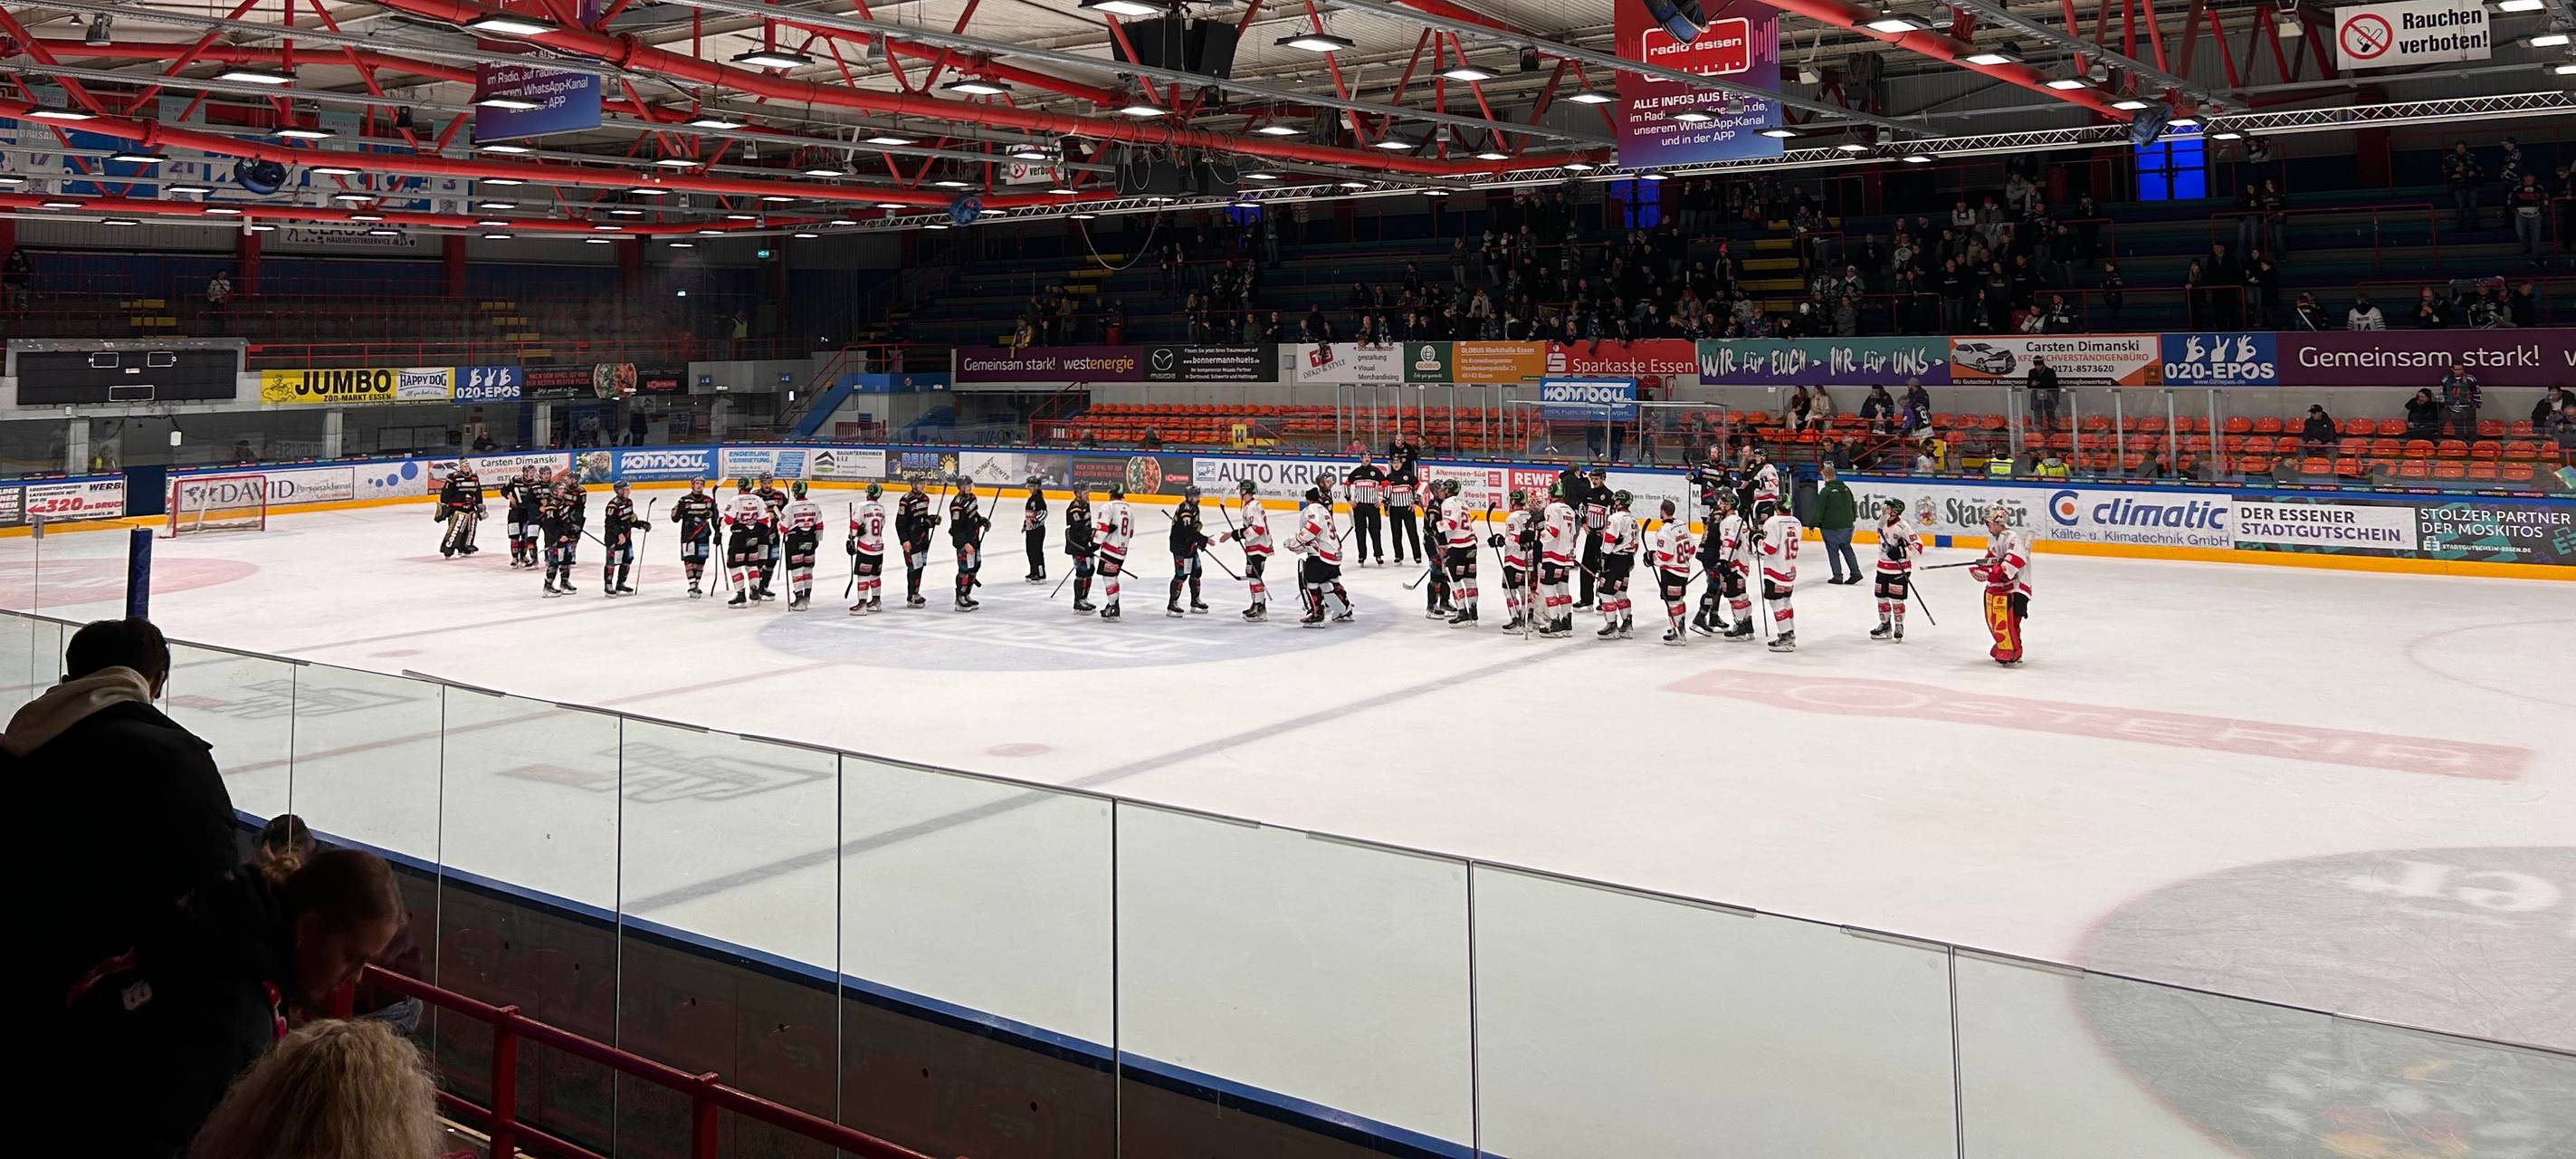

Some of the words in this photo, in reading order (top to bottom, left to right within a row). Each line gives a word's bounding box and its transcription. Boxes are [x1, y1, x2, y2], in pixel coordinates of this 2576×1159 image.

[2402, 8, 2482, 30] Rauchen
[1650, 43, 1690, 56] radio
[1694, 38, 1741, 51] essen
[2399, 31, 2488, 54] verboten!
[498, 72, 520, 85] Radio,
[523, 77, 588, 96] WhatsApp-Kanal
[548, 95, 567, 109] APP
[1633, 99, 1659, 110] ALLE
[1662, 95, 1694, 107] INFOS
[1697, 92, 1720, 103] AUS
[1630, 114, 1642, 123] im
[1634, 123, 1676, 136] unserem
[1679, 115, 1765, 131] WhatsApp-Kanal
[1662, 136, 1681, 147] und
[1682, 135, 1692, 144] in
[1693, 132, 1710, 143] der
[1713, 130, 1736, 142] APP
[326, 235, 391, 245] HAUSMEISTERSERVICE
[2026, 341, 2074, 354] Carsten
[2077, 340, 2140, 353] Dimanski
[964, 357, 1023, 372] Gemeinsam
[1026, 357, 1056, 370] stark!
[1064, 356, 1134, 373] westenergie
[1702, 347, 1736, 377] WIR
[1771, 346, 1807, 375] EUCH
[1829, 346, 1853, 374] IHR
[1894, 346, 1928, 375] UNS
[2299, 346, 2452, 368] Gemeinsam
[2462, 345, 2540, 368] stark!
[1303, 368, 1321, 378] DEKO
[1573, 357, 1646, 377] Sparkasse
[1650, 358, 1694, 374] Essen
[2051, 363, 2114, 374] 0171-8573620
[2164, 362, 2275, 379] 020-EPOS
[294, 369, 392, 396] JUMBO
[400, 374, 428, 388] HAPPY
[429, 373, 447, 387] DOG
[323, 395, 367, 403] ZOO-MARKT
[369, 393, 392, 401] ESSEN
[456, 386, 520, 399] 020-EPOS
[1544, 383, 1625, 403] wohnbau
[481, 457, 513, 467] Carsten
[515, 455, 558, 465] Dimanski
[621, 454, 703, 469] wohnbau
[902, 453, 939, 469] REISE
[1218, 463, 1276, 483] AUTO
[1280, 464, 1350, 485] KRUSE
[1436, 469, 1486, 478] Altenessen-Süd
[1514, 472, 1553, 486] REWE
[220, 480, 295, 503] DAVID
[46, 497, 83, 512] 320
[2094, 497, 2228, 530] climatic
[2240, 507, 2275, 521] DER
[2279, 508, 2355, 524] ESSENER
[2419, 507, 2491, 523] STOLZER
[2496, 509, 2571, 525] PARTNER
[2051, 528, 2088, 541] Kälte-
[2104, 529, 2183, 544] Klimatechnik
[2188, 534, 2229, 547] GmbH
[2241, 522, 2401, 542] STADTGUTSCHEIN
[2421, 522, 2456, 534] DER
[2457, 522, 2544, 539] MOSKITOS
[2442, 543, 2532, 553] STADTGUTSCHEIN-ESSEN.DE
